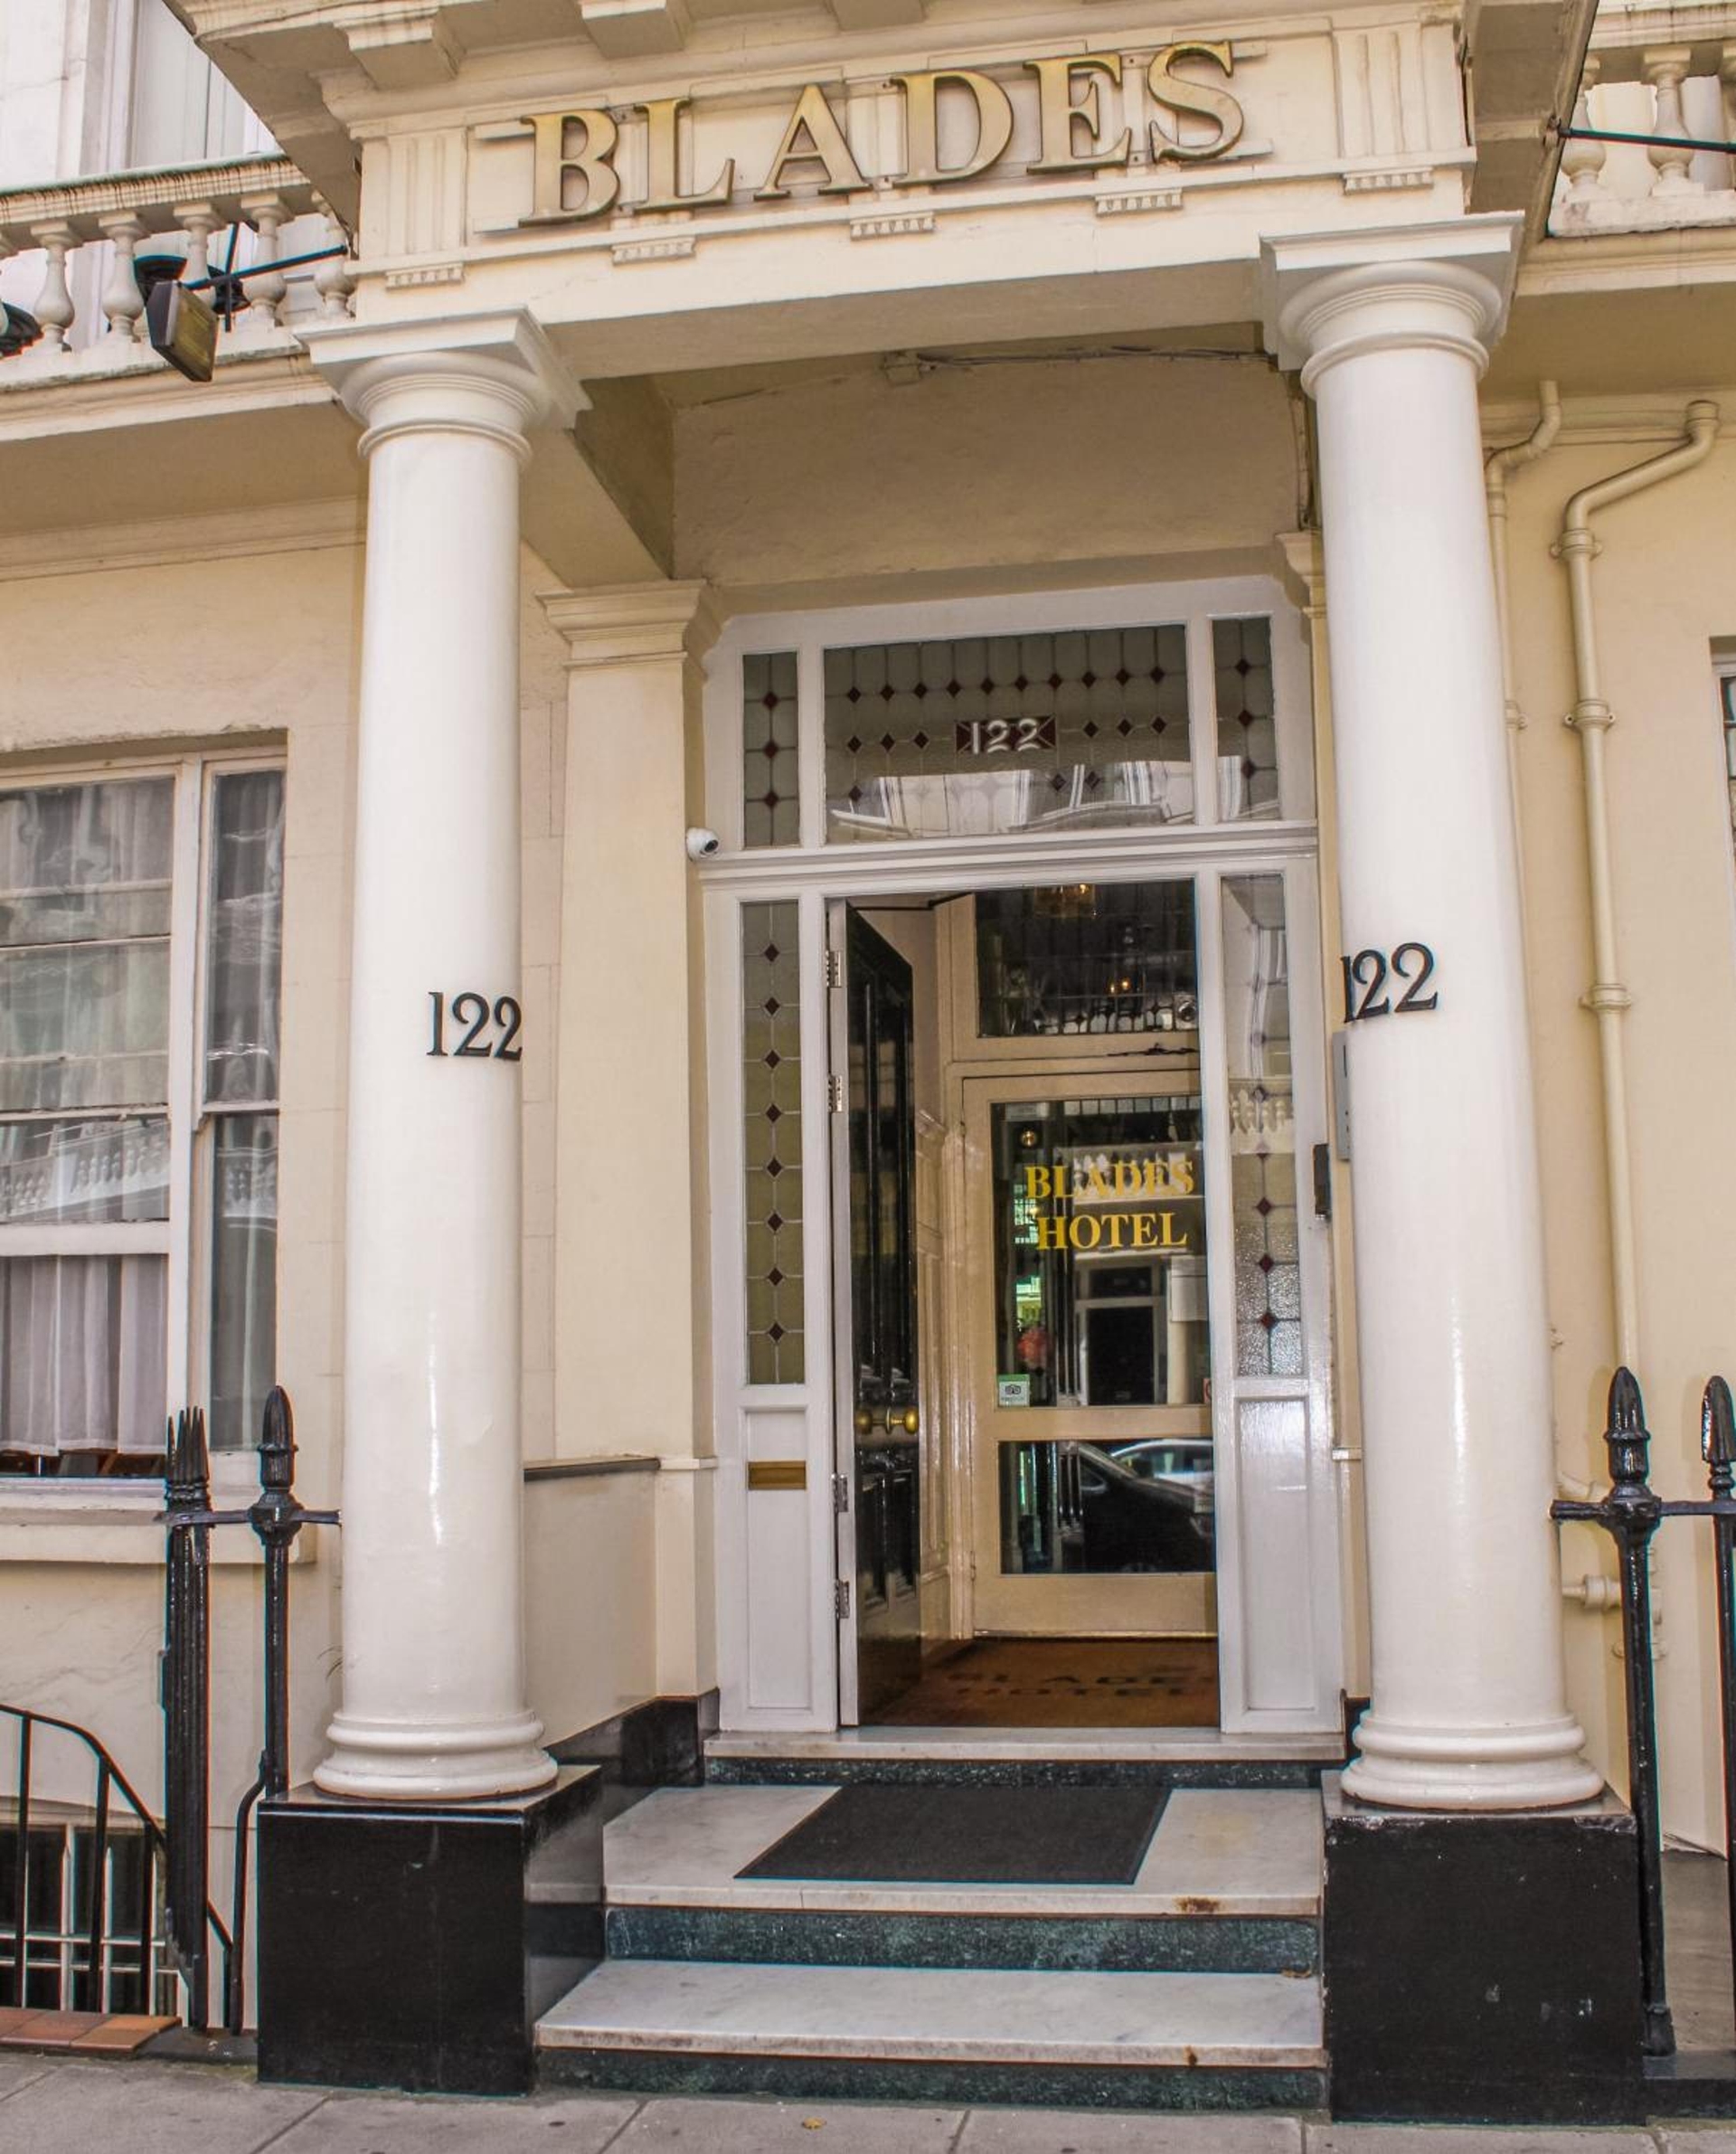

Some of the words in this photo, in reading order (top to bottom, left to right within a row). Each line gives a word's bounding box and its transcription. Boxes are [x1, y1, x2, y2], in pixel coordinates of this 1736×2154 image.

[519, 40, 1245, 228] BLADES
[972, 718, 1041, 754] 122
[1339, 942, 1438, 1023] 122
[426, 991, 524, 1062] 122
[1024, 1160, 1195, 1199] BLADES
[1037, 1213, 1187, 1250] HOTEL
